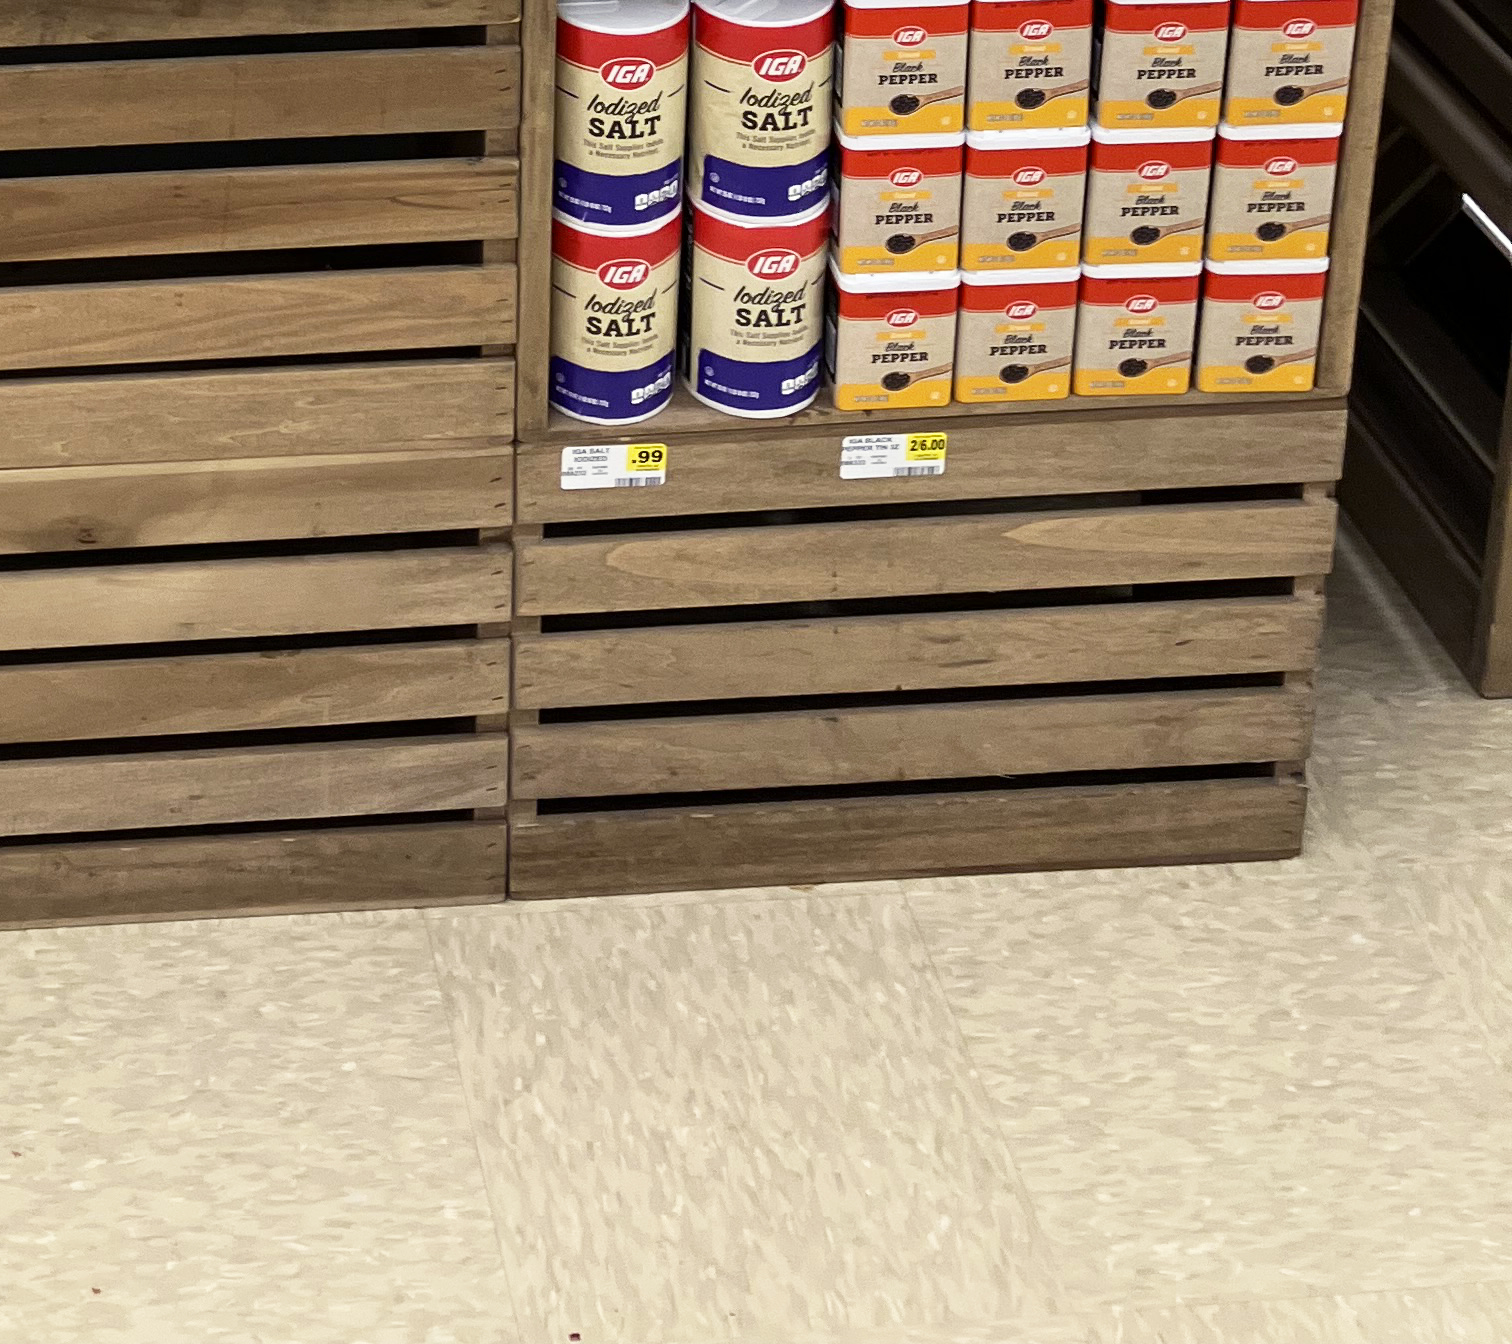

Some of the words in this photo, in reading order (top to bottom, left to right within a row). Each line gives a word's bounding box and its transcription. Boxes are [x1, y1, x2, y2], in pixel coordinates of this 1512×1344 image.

[1022, 23, 1051, 37] IGA
[1156, 24, 1186, 39] IGA
[1284, 20, 1314, 36] IGA
[897, 30, 925, 43] IGA
[757, 55, 805, 77] IGA
[1018, 55, 1050, 67] Black
[1151, 56, 1182, 68] Black
[1279, 52, 1310, 65] Black
[604, 63, 651, 85] IGA
[892, 61, 925, 73] Black
[1004, 66, 1065, 80] PEPPER
[1136, 66, 1198, 81] PEPPER
[1264, 63, 1325, 78] PEPPER
[877, 73, 939, 86] PEPPER
[738, 81, 814, 115] Iodized
[586, 89, 664, 126] Iodized
[740, 105, 815, 133] SALT
[587, 114, 662, 142] SALT
[1120, 203, 1180, 218] PEPPER
[1246, 199, 1306, 215] PEPPER
[874, 210, 934, 226] PEPPER
[996, 209, 1056, 225] PEPPER
[752, 252, 799, 275] IGA
[603, 263, 648, 285] IGA
[732, 277, 808, 313] Iodized
[583, 288, 658, 322] Iodized
[584, 310, 657, 339] SALT
[734, 303, 807, 330] SALT
[1108, 336, 1166, 351] PEPPER
[1235, 333, 1294, 348] PEPPER
[871, 350, 929, 366] PEPPER
[989, 342, 1048, 358] PEPPER
[630, 448, 664, 466] .99
